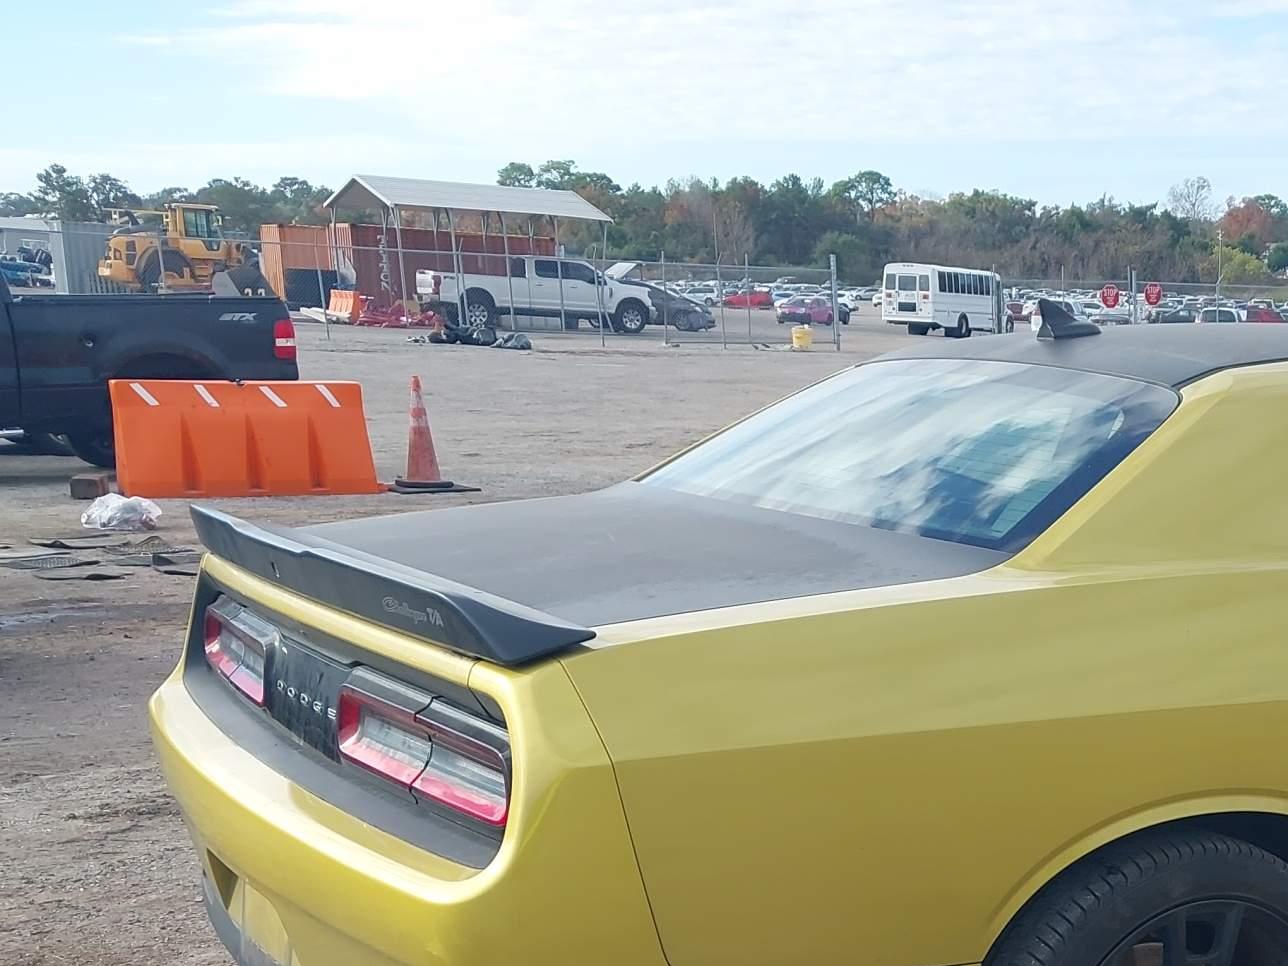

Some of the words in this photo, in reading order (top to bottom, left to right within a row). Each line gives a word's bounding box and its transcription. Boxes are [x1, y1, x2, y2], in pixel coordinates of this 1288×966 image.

[1104, 288, 1117, 297] STOP
[1147, 286, 1159, 294] STOP
[276, 679, 337, 720] DODGE
